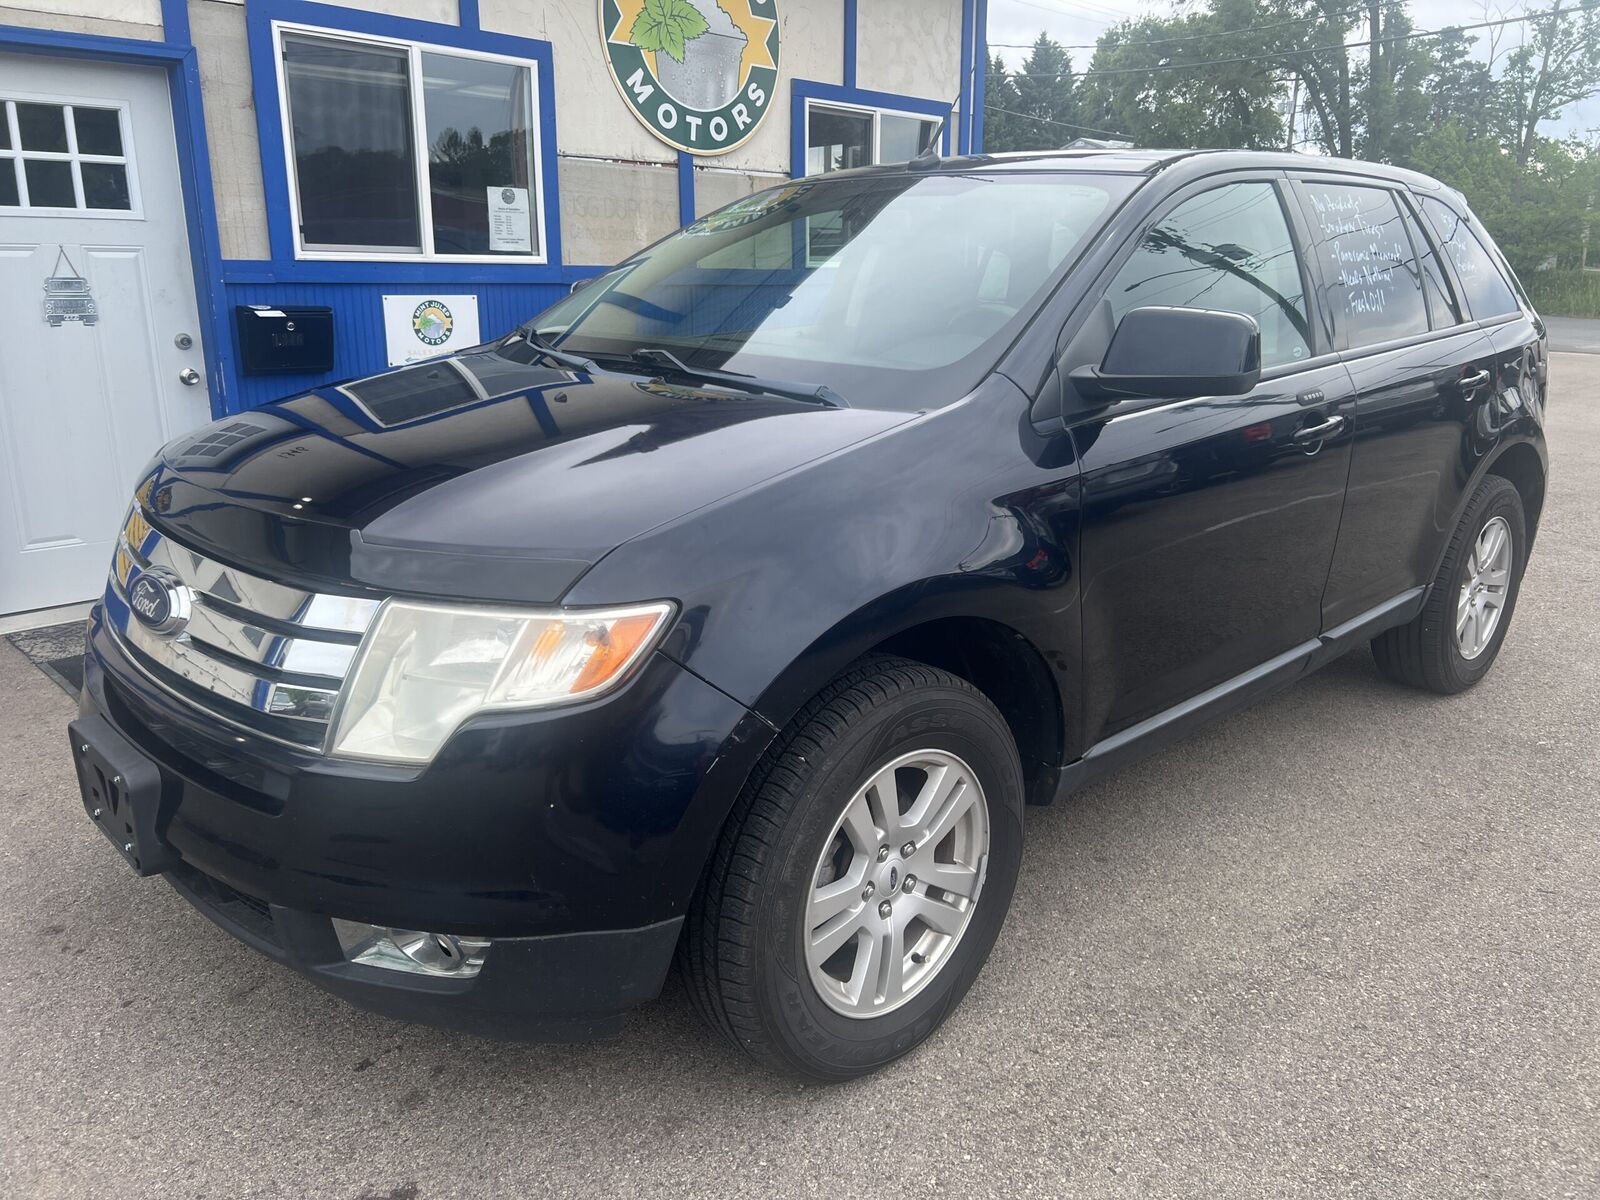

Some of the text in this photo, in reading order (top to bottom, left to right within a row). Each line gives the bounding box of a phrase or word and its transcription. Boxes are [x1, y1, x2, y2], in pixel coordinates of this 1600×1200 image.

[625, 67, 765, 141] MOTORS
[415, 301, 450, 318] MINT JULEP
[418, 331, 451, 345] MOTORS
[132, 580, 160, 618] Ford
